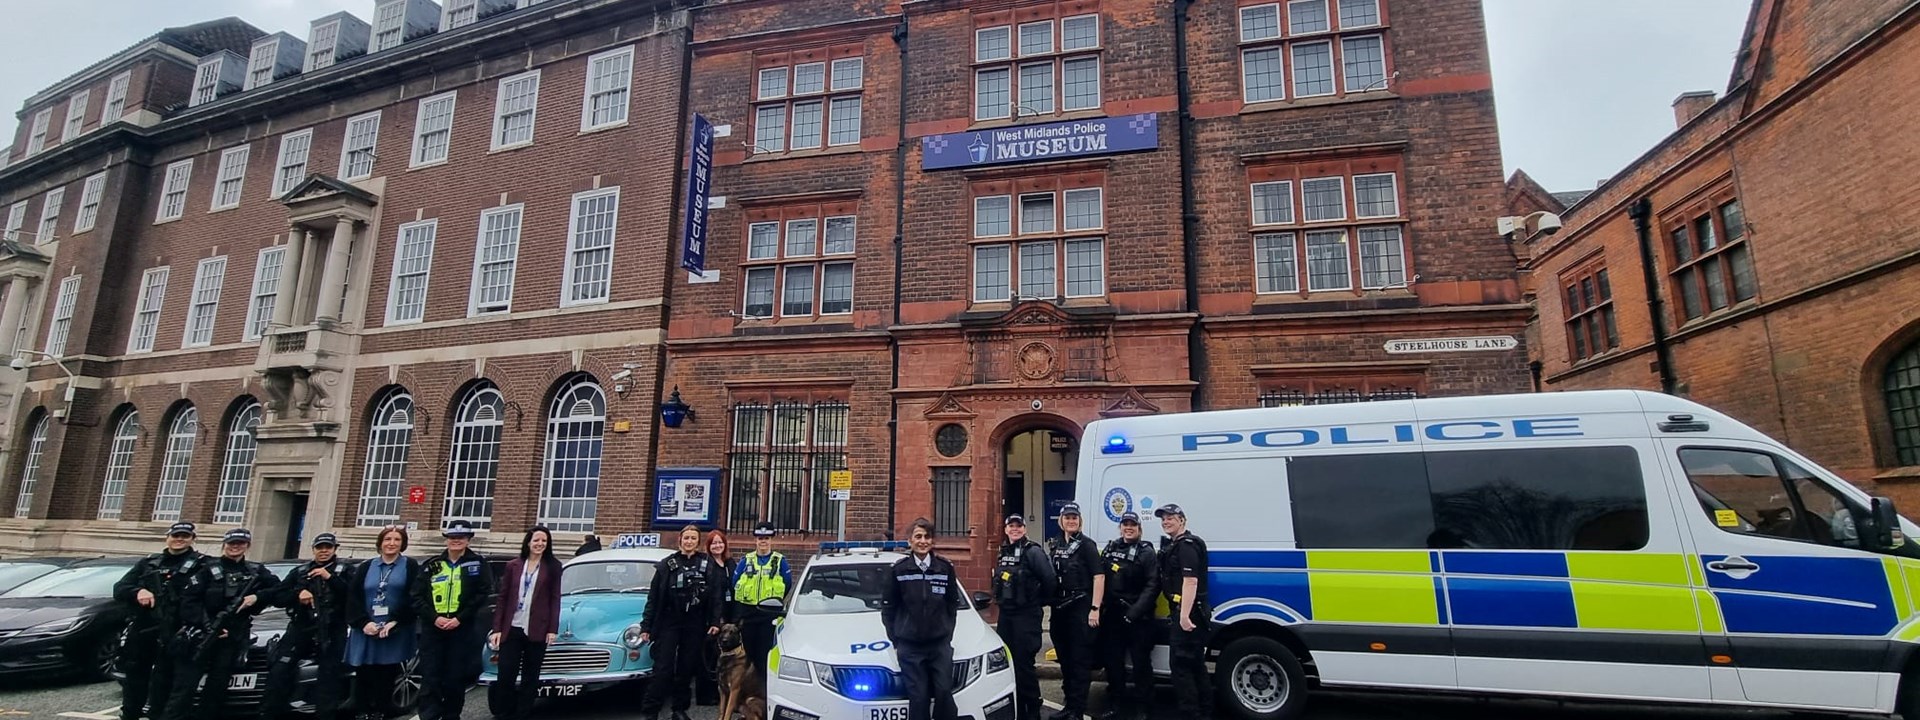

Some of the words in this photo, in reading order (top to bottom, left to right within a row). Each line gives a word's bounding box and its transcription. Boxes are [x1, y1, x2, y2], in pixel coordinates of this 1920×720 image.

[996, 130, 1021, 142] West
[1024, 125, 1071, 139] Midlands
[1074, 122, 1106, 134] Police
[996, 133, 1108, 160] MUSEUM
[689, 163, 708, 255] MUSEUM
[1394, 340, 1468, 351] STEELHOUSE
[1475, 339, 1507, 348] LANE
[1182, 417, 1584, 452] POLICE
[620, 535, 657, 546] POLICE
[537, 686, 552, 697] YT
[555, 685, 583, 697] 712F
